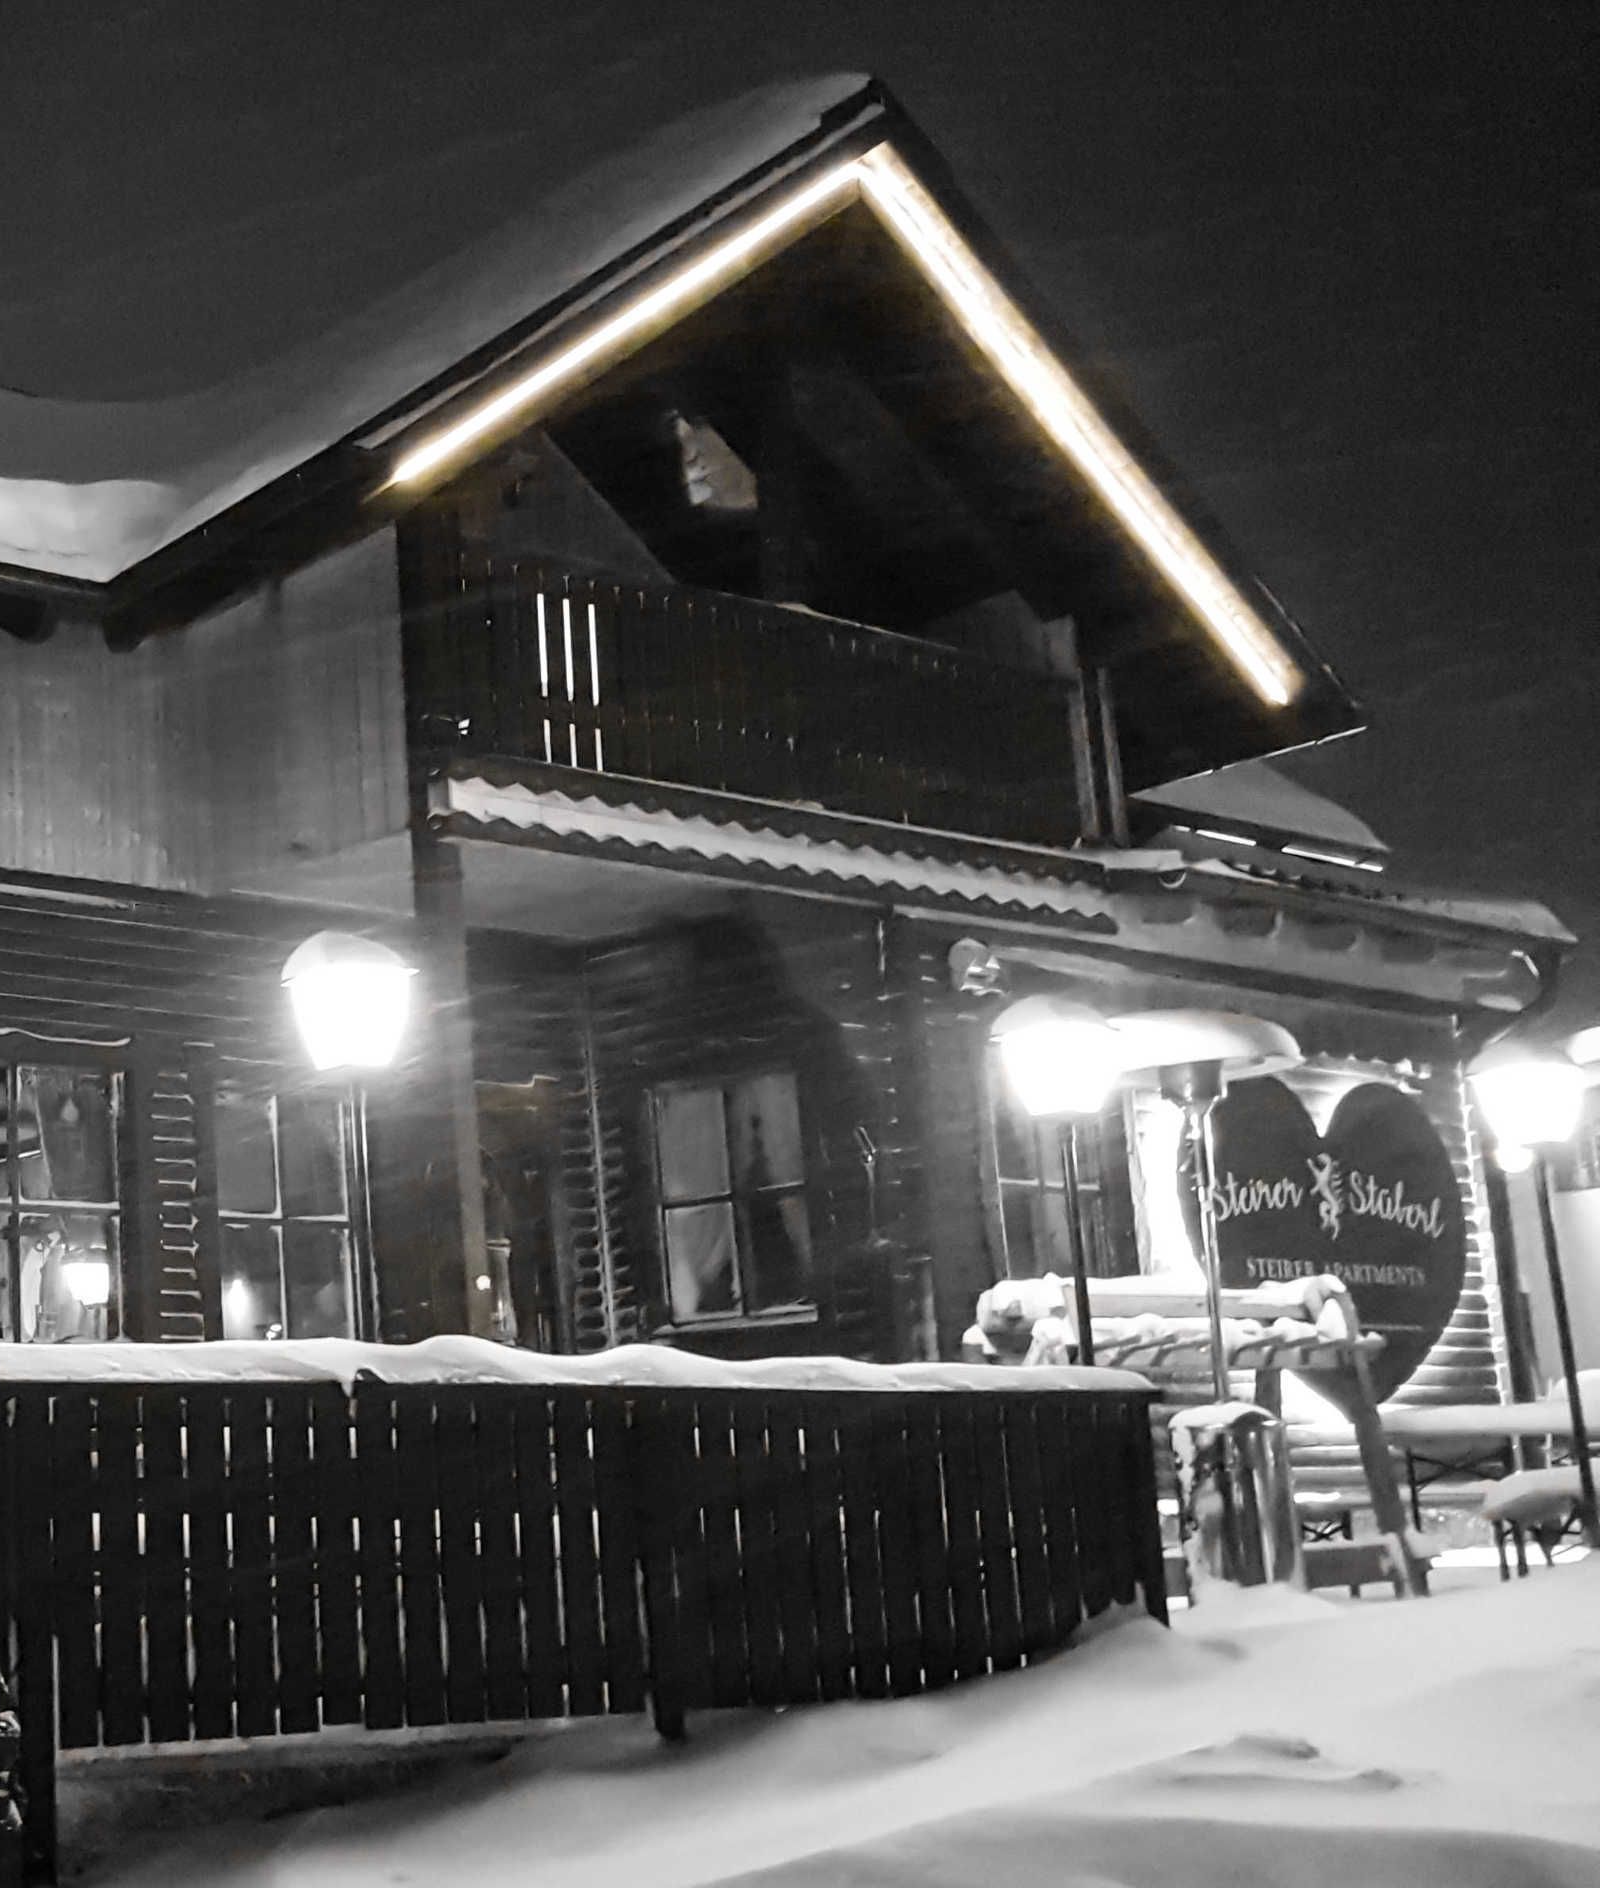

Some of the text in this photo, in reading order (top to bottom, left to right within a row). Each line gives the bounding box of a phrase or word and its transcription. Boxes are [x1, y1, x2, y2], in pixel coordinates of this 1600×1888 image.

[1204, 1171, 1304, 1221] Steirer
[1247, 1257, 1426, 1286] STEIRER APARTMENTS
